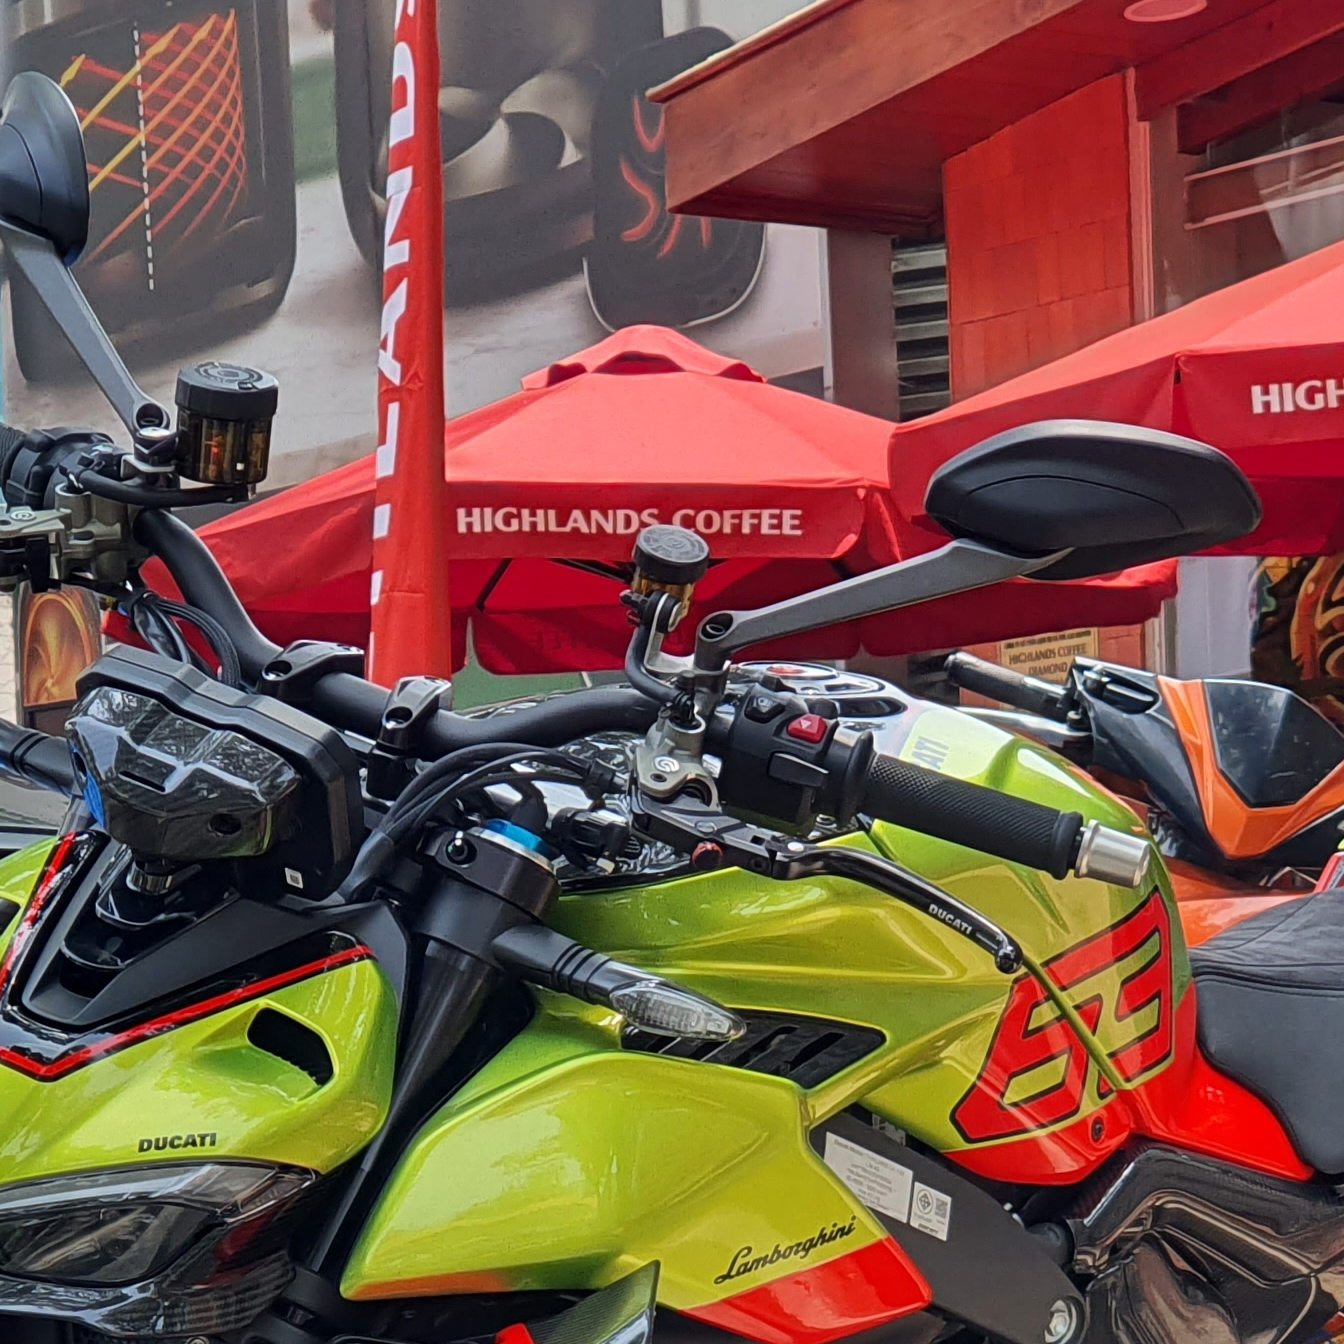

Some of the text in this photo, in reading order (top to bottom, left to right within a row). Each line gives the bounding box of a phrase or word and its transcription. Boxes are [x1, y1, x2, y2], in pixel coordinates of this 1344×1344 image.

[456, 506, 803, 536] HIGHLANDS COFFEE
[928, 903, 973, 935] DUCATI
[137, 1132, 217, 1153] DUCATI
[713, 1215, 857, 1285] Lamborghini
